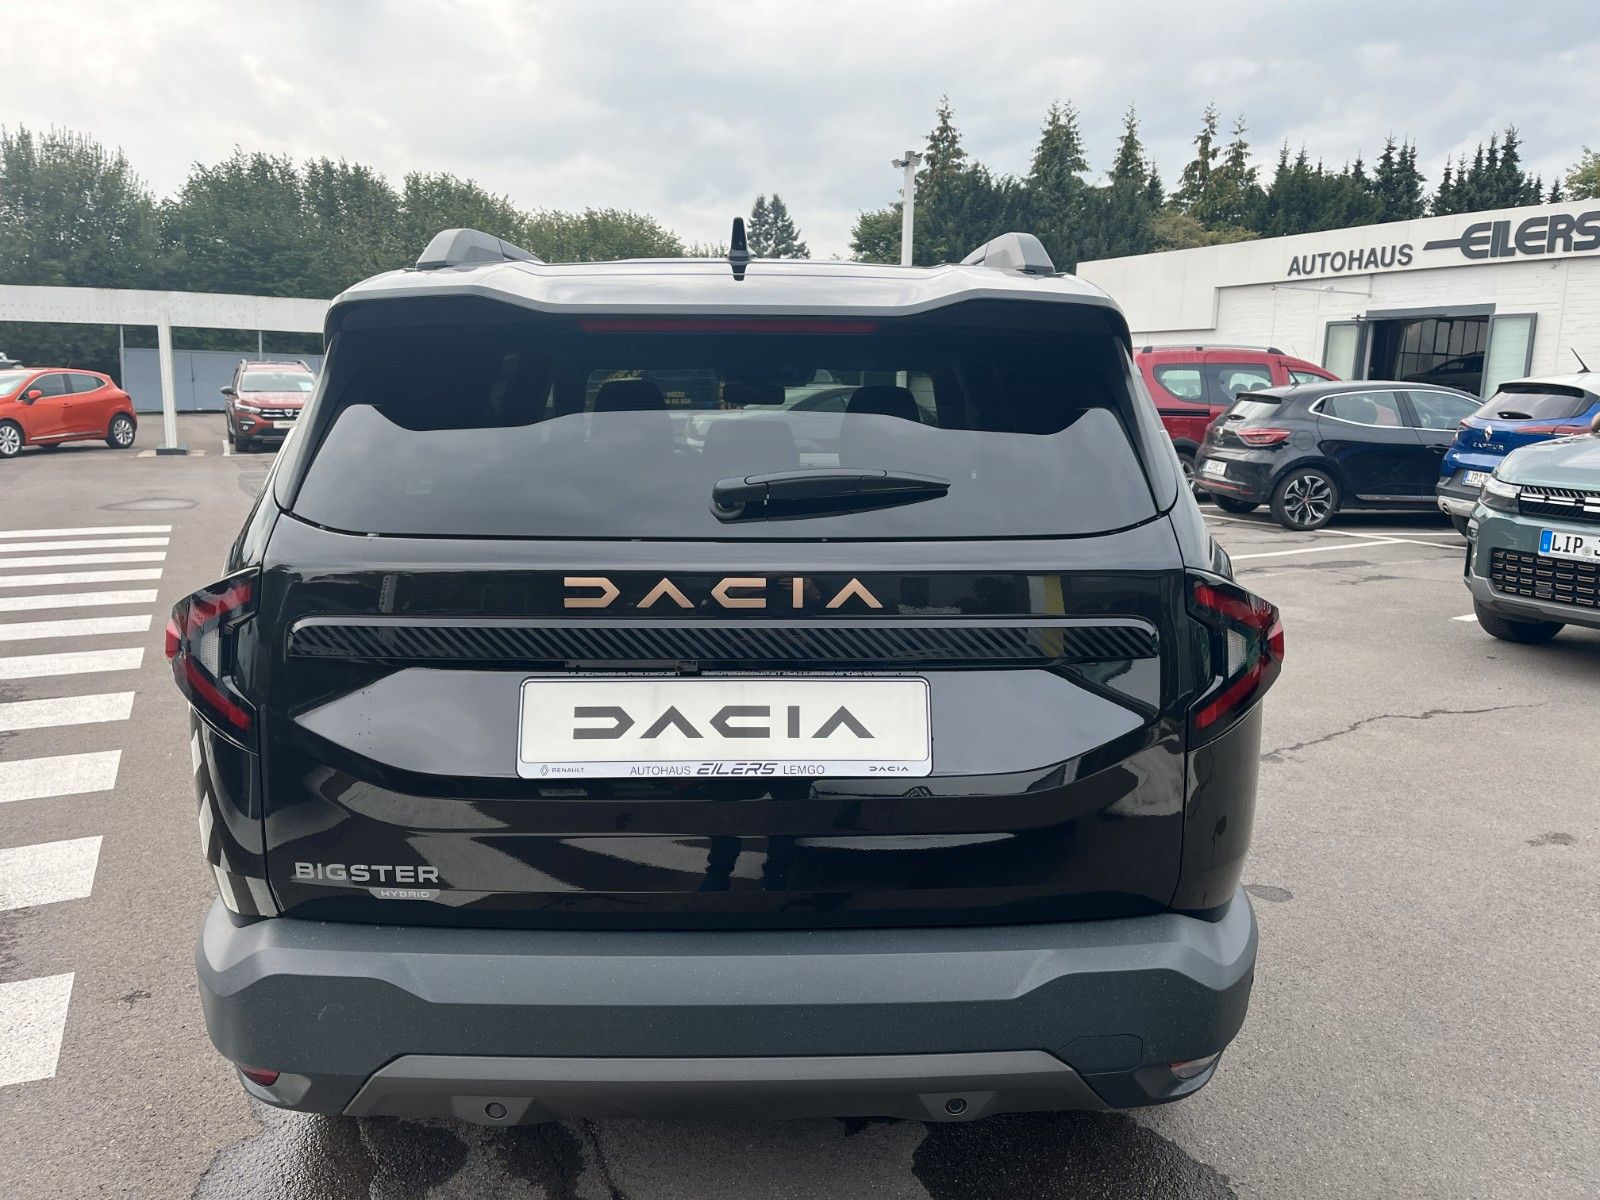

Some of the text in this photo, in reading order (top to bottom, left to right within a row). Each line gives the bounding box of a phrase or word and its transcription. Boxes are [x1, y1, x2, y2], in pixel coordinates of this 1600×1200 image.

[1287, 210, 1600, 277] AUTOHAUS EILERS
[1472, 441, 1504, 451] CAPTUR
[1552, 534, 1584, 554] LIP
[563, 576, 883, 609] DACIA
[573, 705, 875, 740] DACIA
[551, 766, 585, 774] RENAULT
[629, 762, 826, 776] AUTOHAUS EILERS LEMGO
[294, 861, 440, 884] BIGSTER
[380, 889, 430, 898] HYBRID
